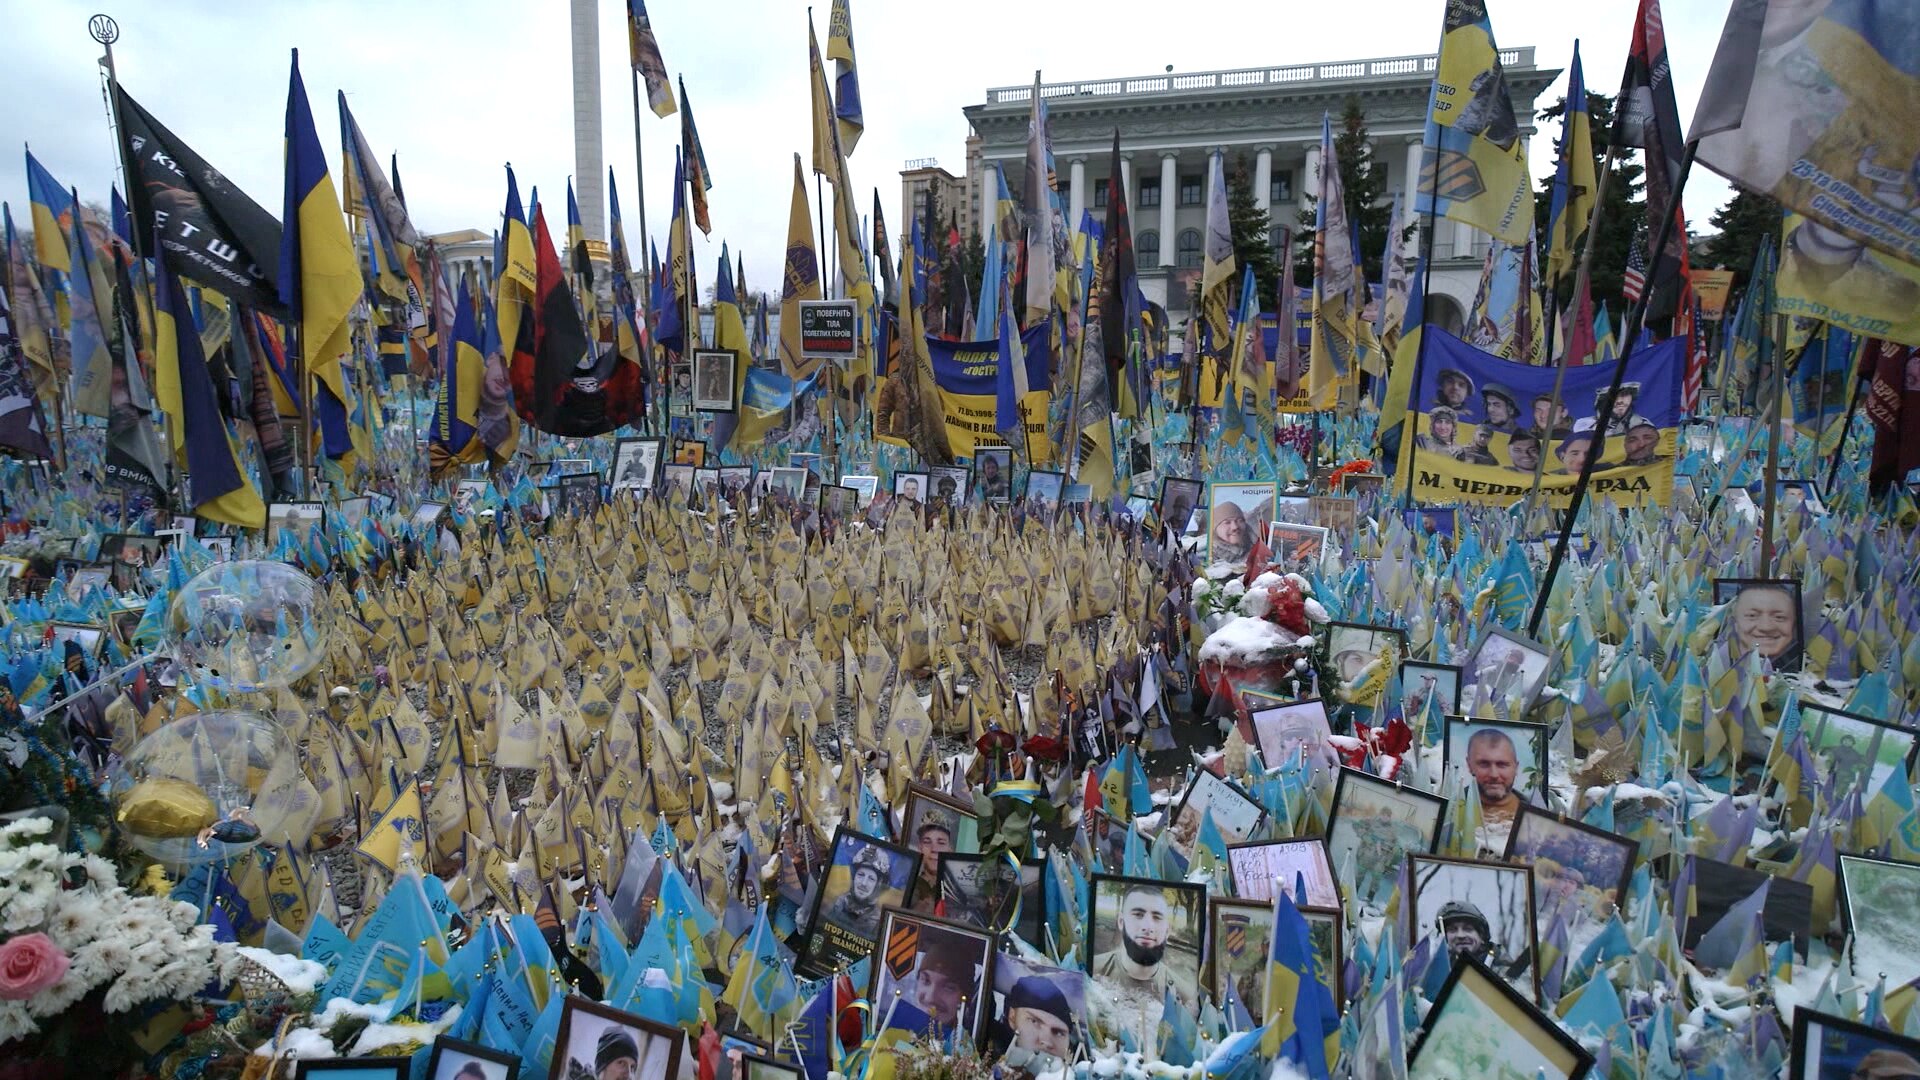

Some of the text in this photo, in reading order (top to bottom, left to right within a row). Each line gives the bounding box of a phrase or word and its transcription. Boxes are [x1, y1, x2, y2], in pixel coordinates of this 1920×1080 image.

[904, 157, 939, 169] ГОТЕЛЬ
[816, 309, 851, 318] ПОВЕРНІТЬ
[826, 320, 841, 328] ТІЛА
[803, 329, 851, 338] ПОЛЕГЛИХ ГЕРОЇВ
[973, 421, 980, 433] В
[1418, 470, 1446, 490] М.
[746, 885, 757, 914] АЗОВ
[824, 922, 844, 935] ІГОР
